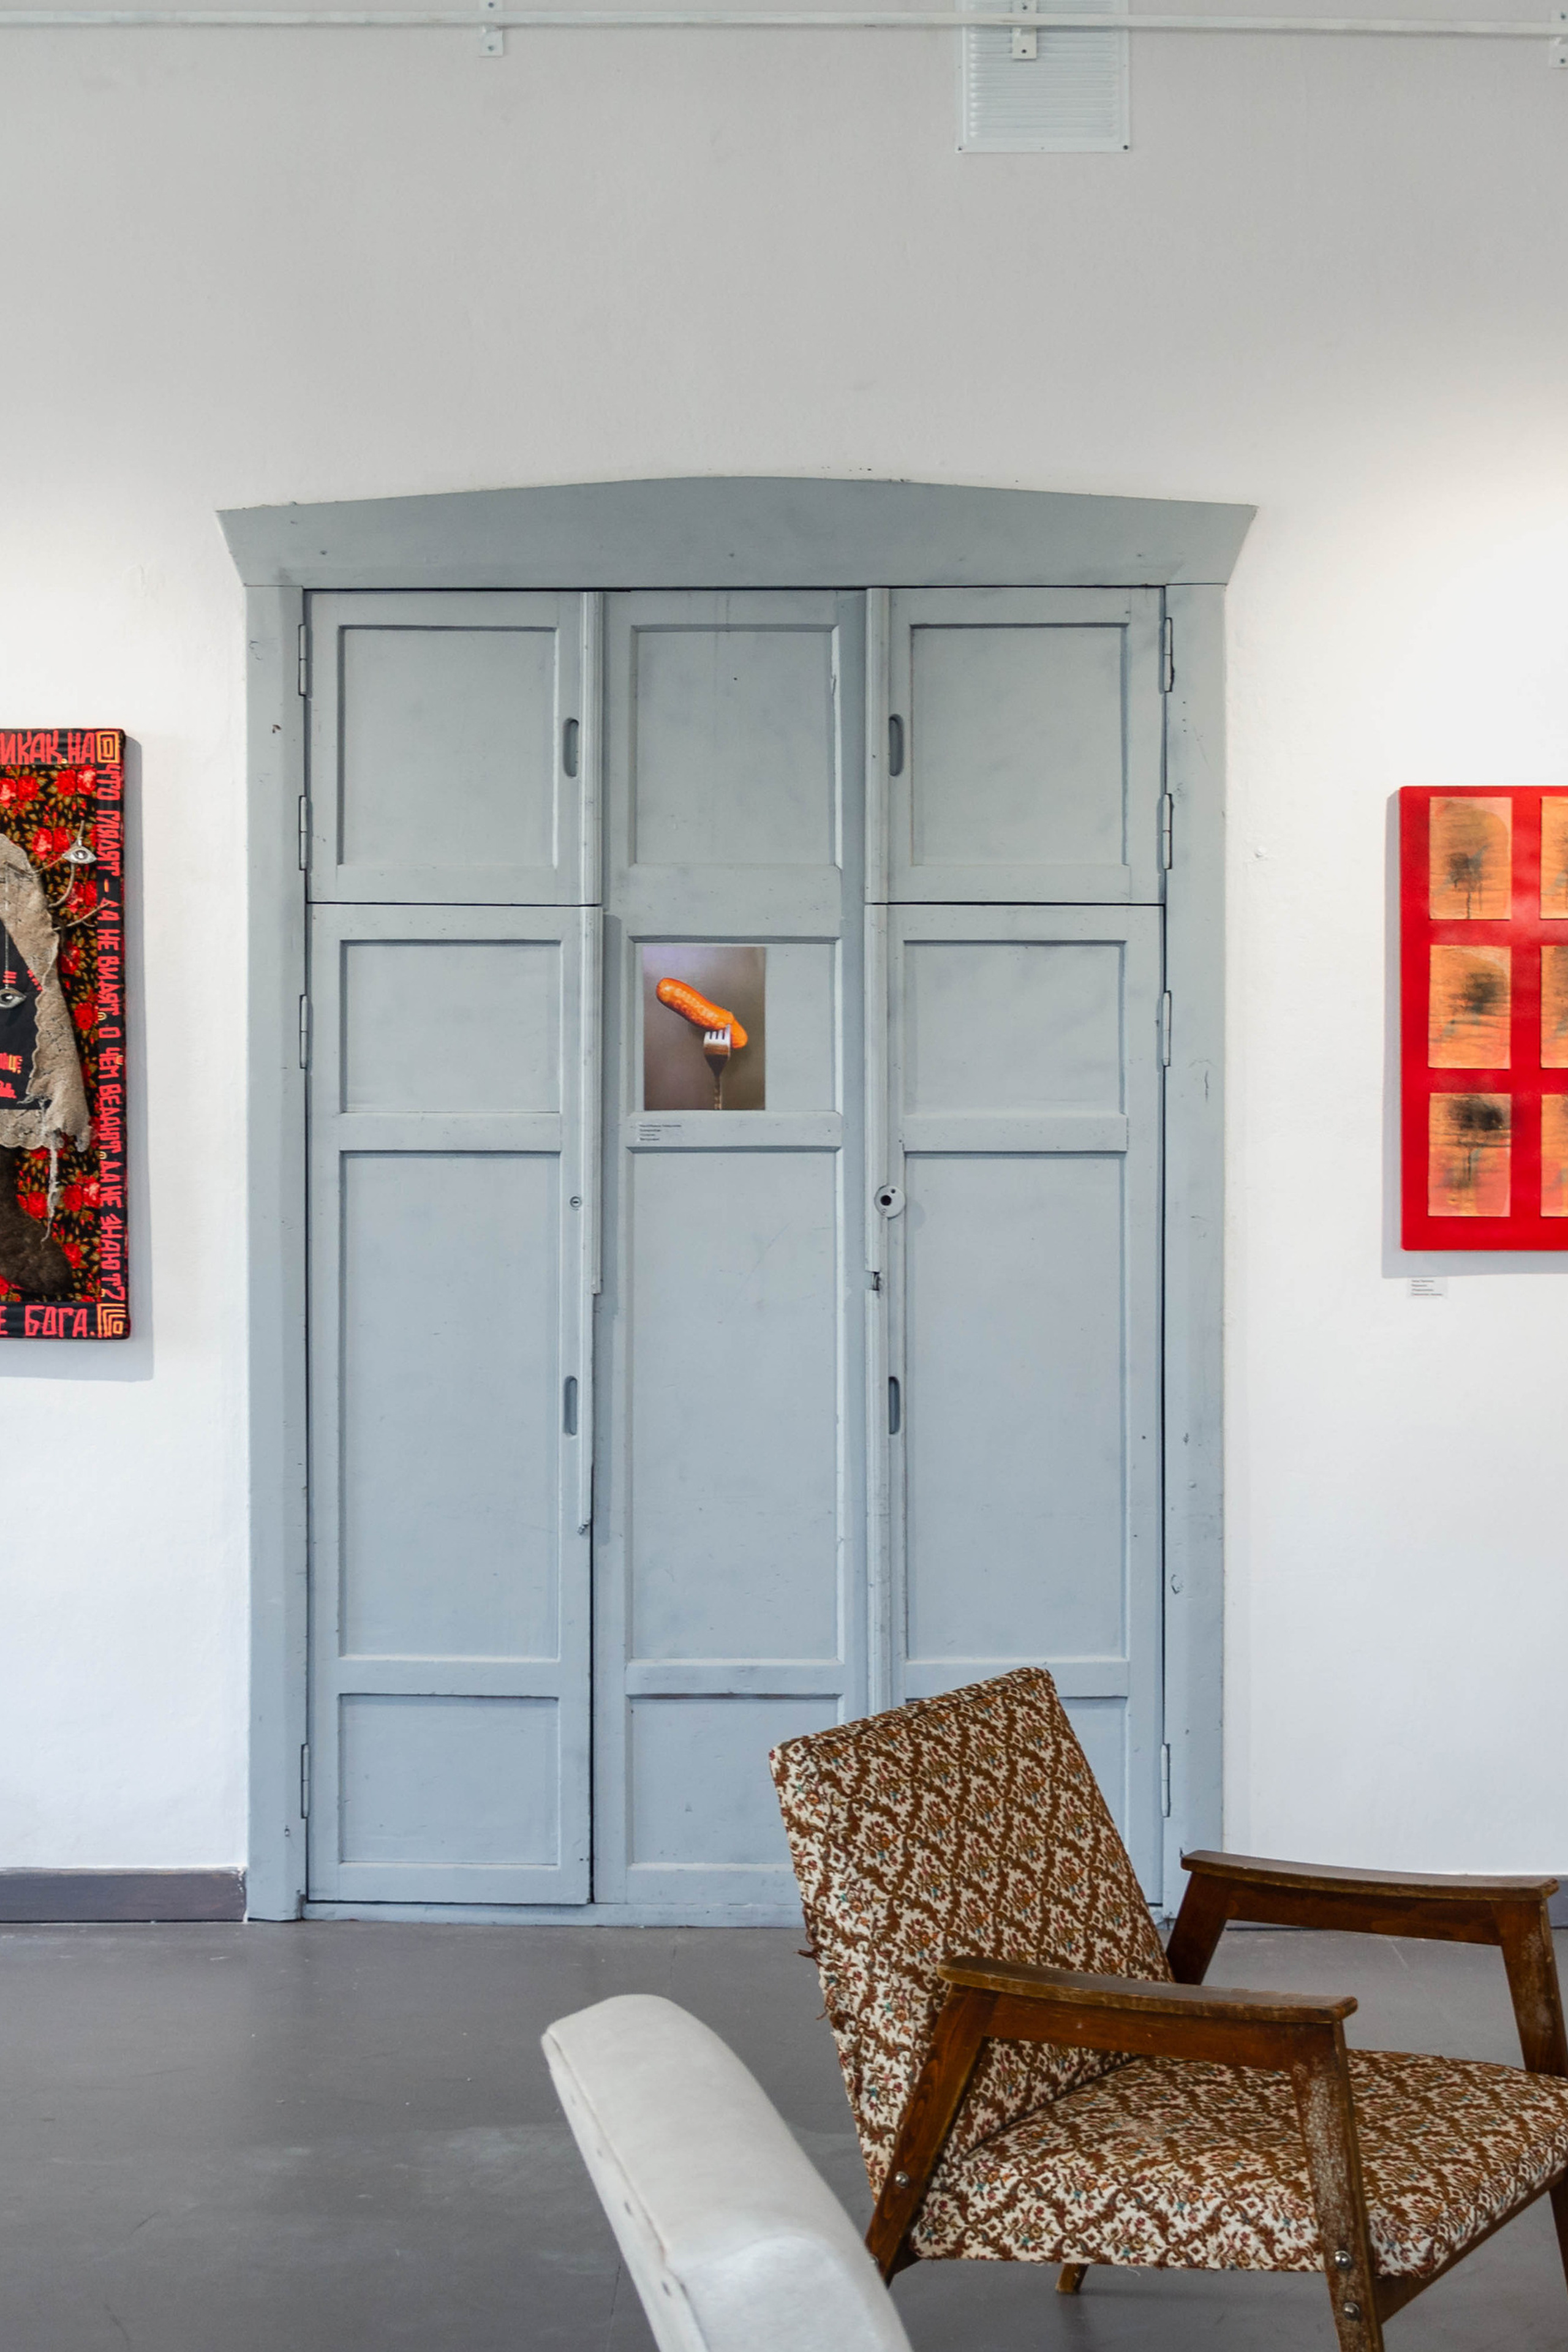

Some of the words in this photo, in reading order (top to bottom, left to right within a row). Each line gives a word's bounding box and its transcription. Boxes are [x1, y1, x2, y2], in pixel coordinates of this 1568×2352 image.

[67, 732, 95, 764] НА
[96, 764, 121, 800] ЧТО
[96, 810, 121, 876] ГЛЯДЯТ
[97, 897, 121, 921] ДА
[97, 929, 121, 951] НЕ
[99, 1161, 123, 1183] ДА
[100, 1185, 124, 1208] НЕ
